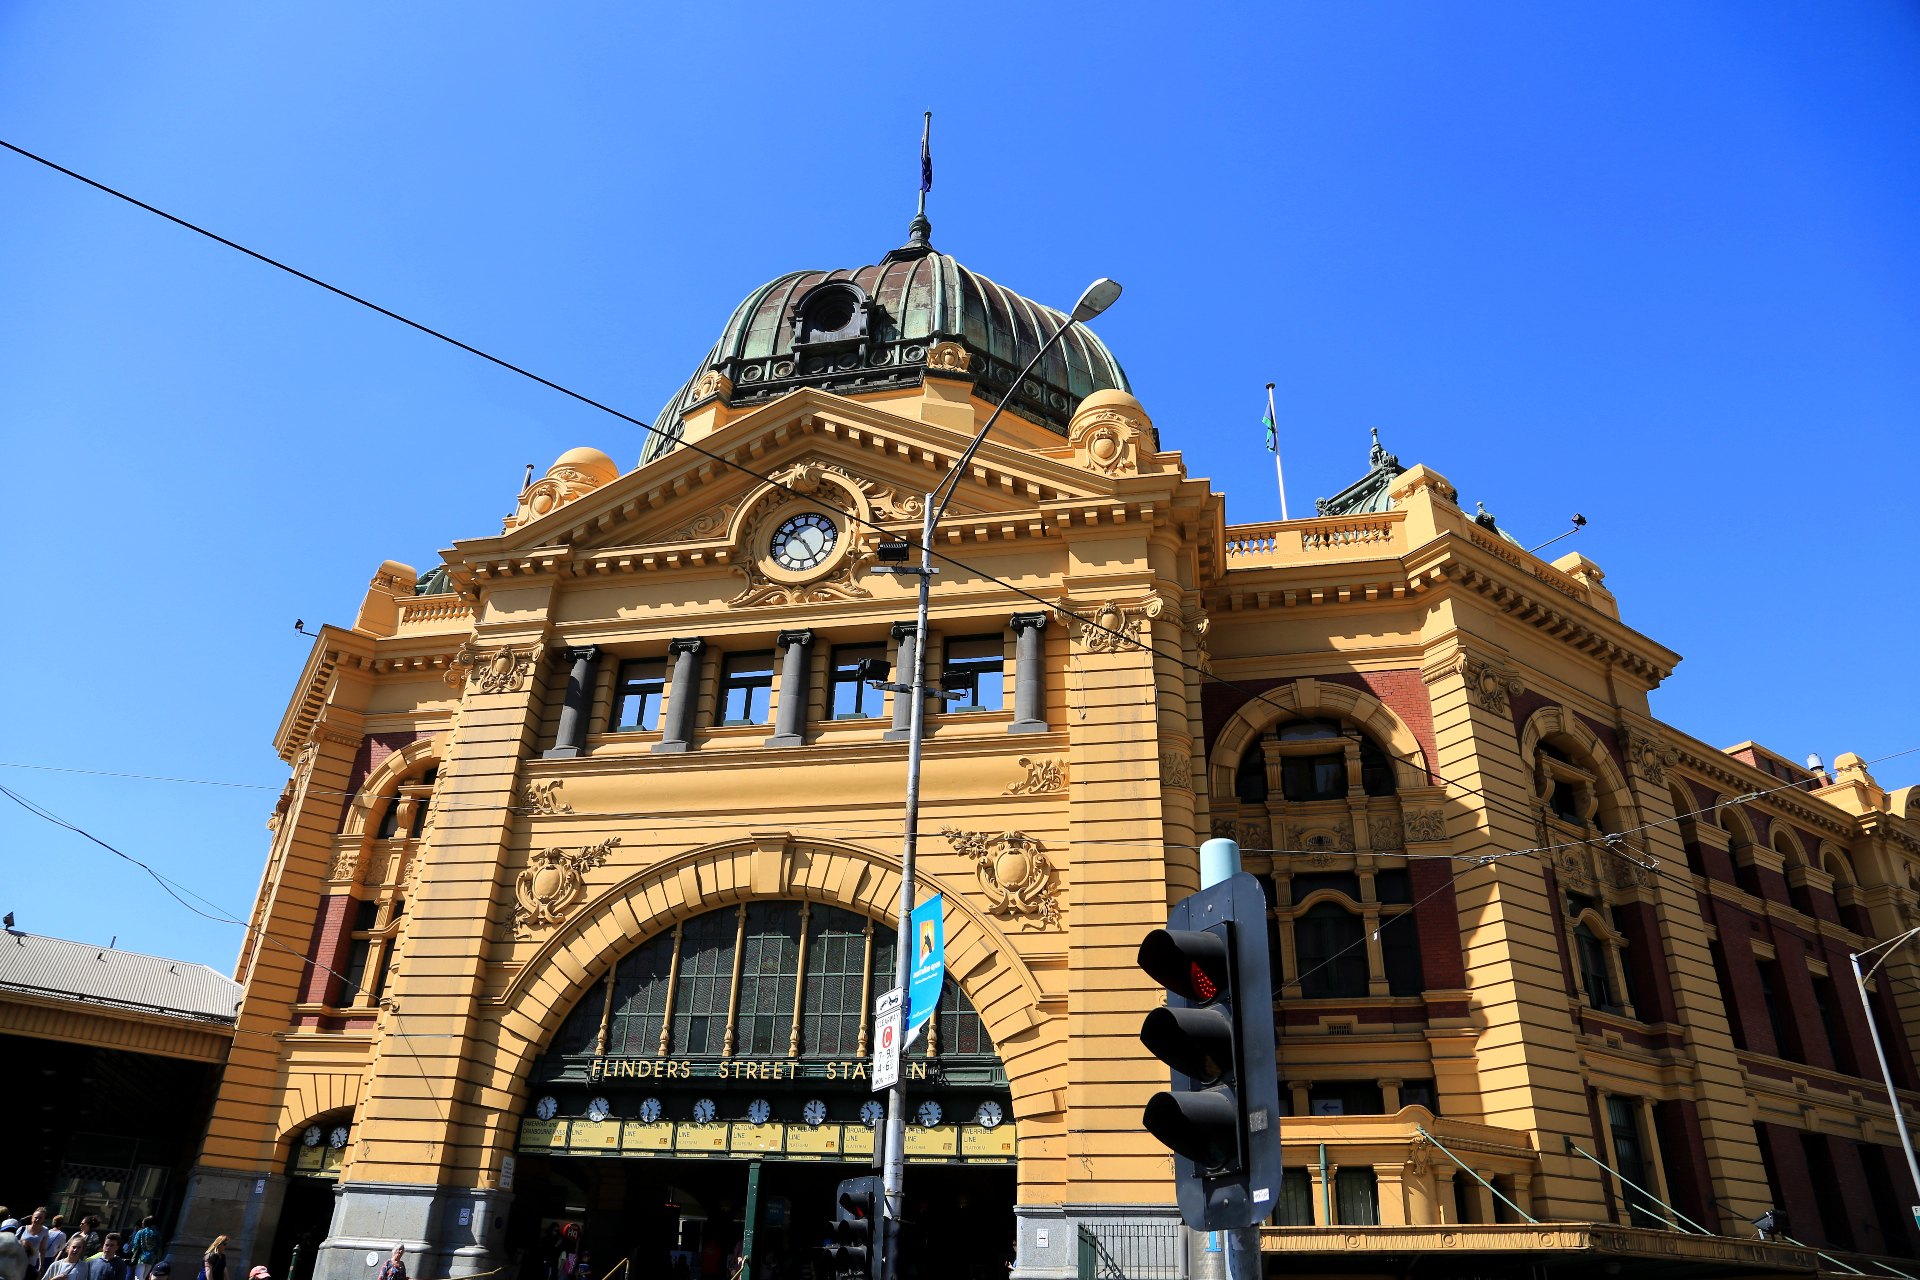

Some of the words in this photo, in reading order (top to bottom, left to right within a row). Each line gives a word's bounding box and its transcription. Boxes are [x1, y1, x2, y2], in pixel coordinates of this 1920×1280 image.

[877, 1013, 899, 1029] CLEARWAY
[592, 1060, 691, 1079] FLINDERS
[719, 1061, 800, 1080] STREET
[826, 1062, 927, 1080] STAN
[904, 1135, 917, 1143] LINE
